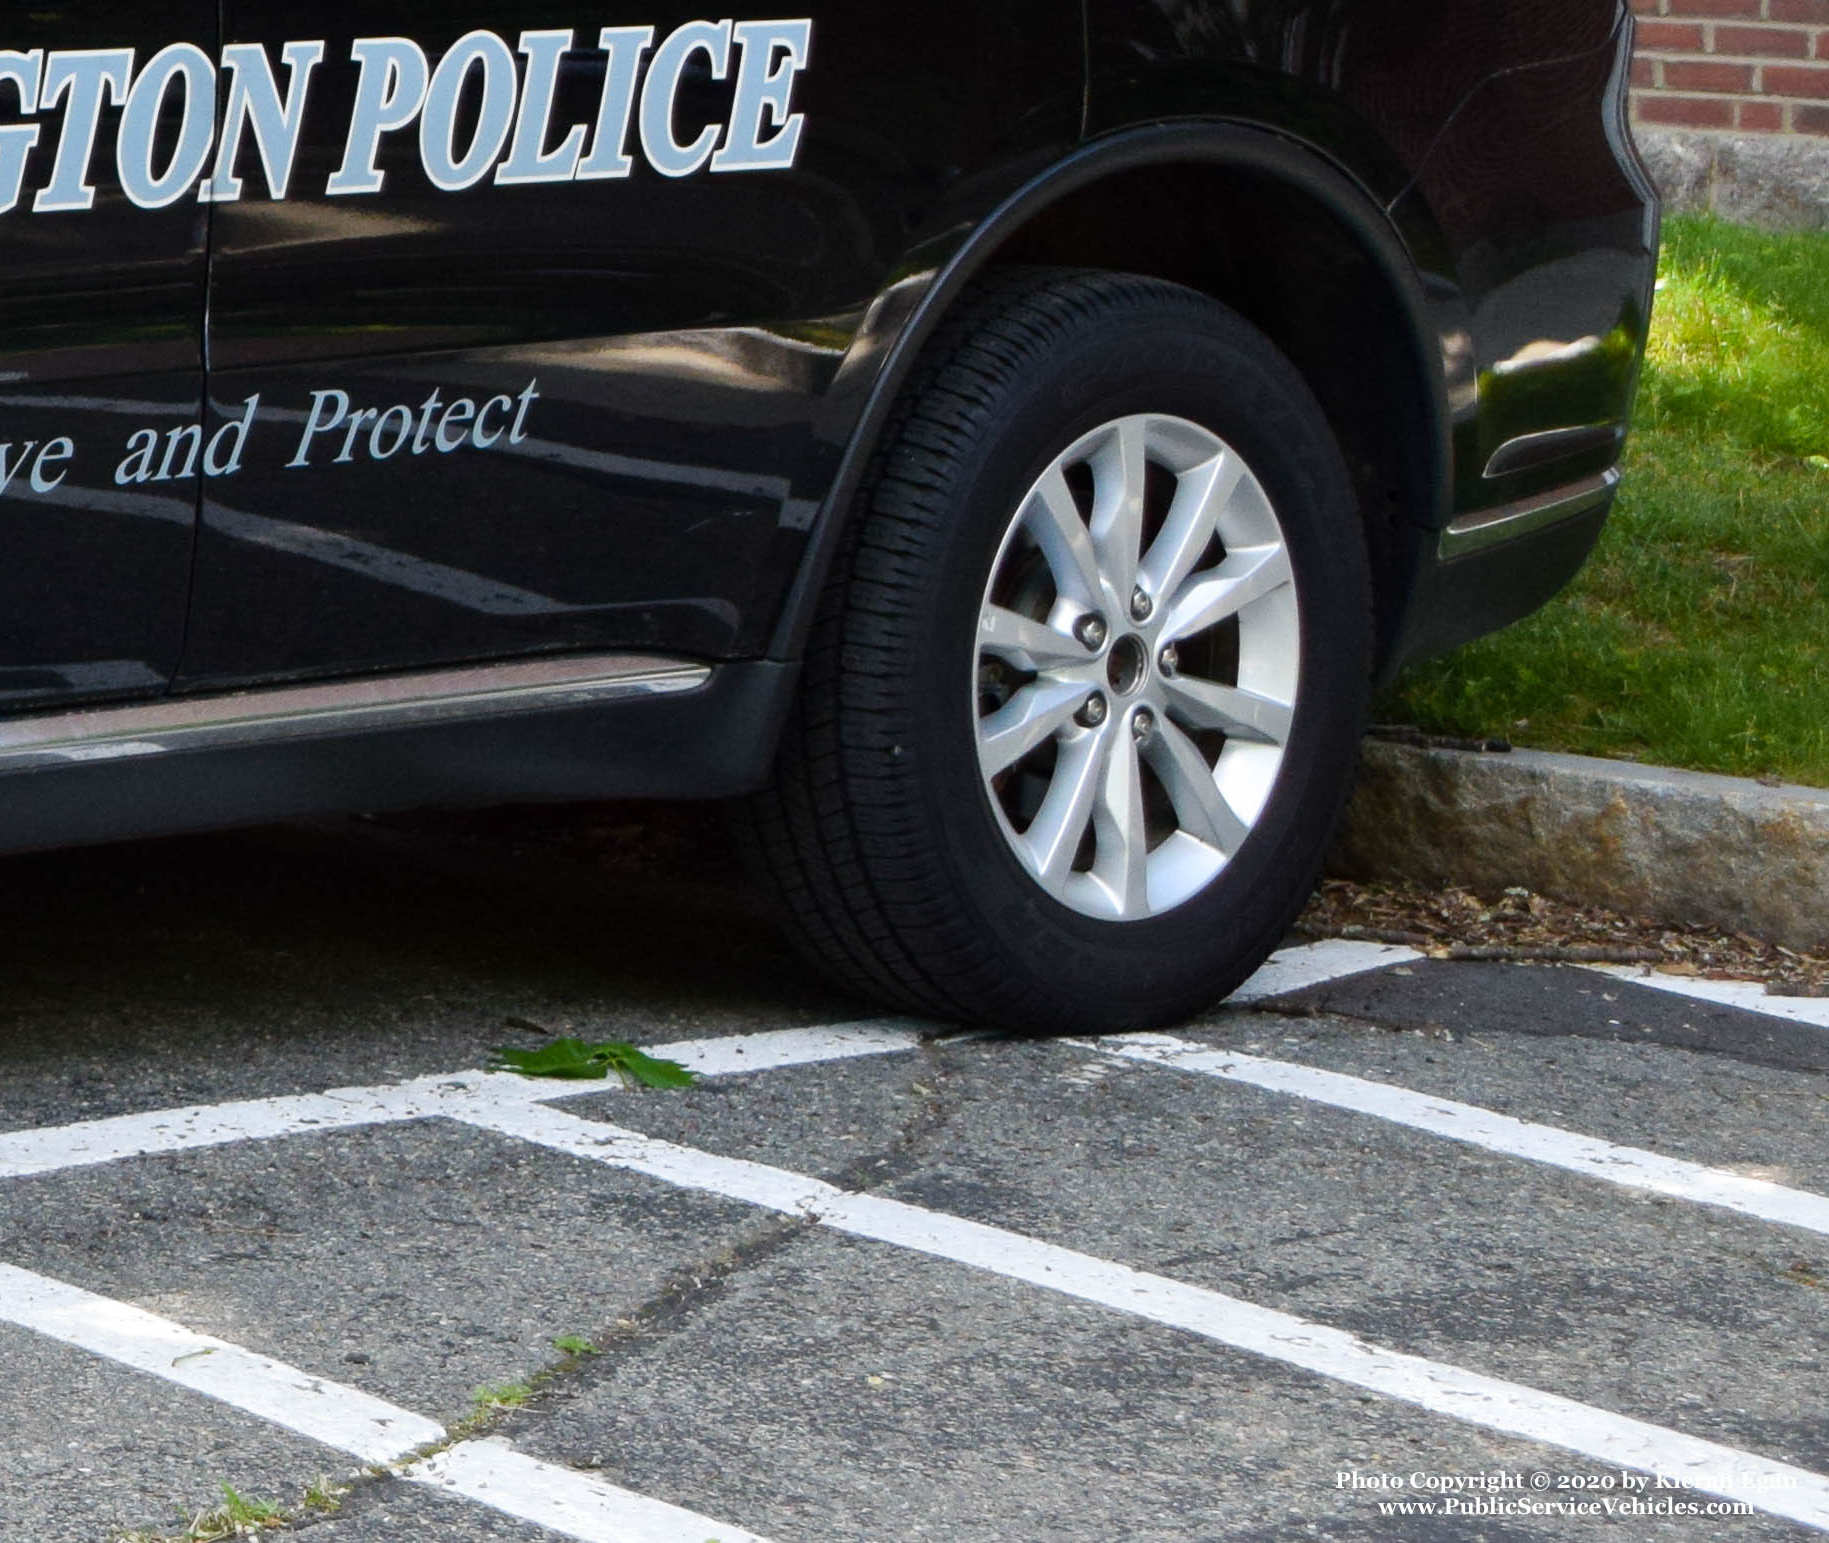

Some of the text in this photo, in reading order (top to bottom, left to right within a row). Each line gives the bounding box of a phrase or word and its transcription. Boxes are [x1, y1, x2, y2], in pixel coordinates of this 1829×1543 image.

[327, 18, 813, 196] POLICE
[114, 394, 261, 487] and
[287, 376, 541, 472] Protect
